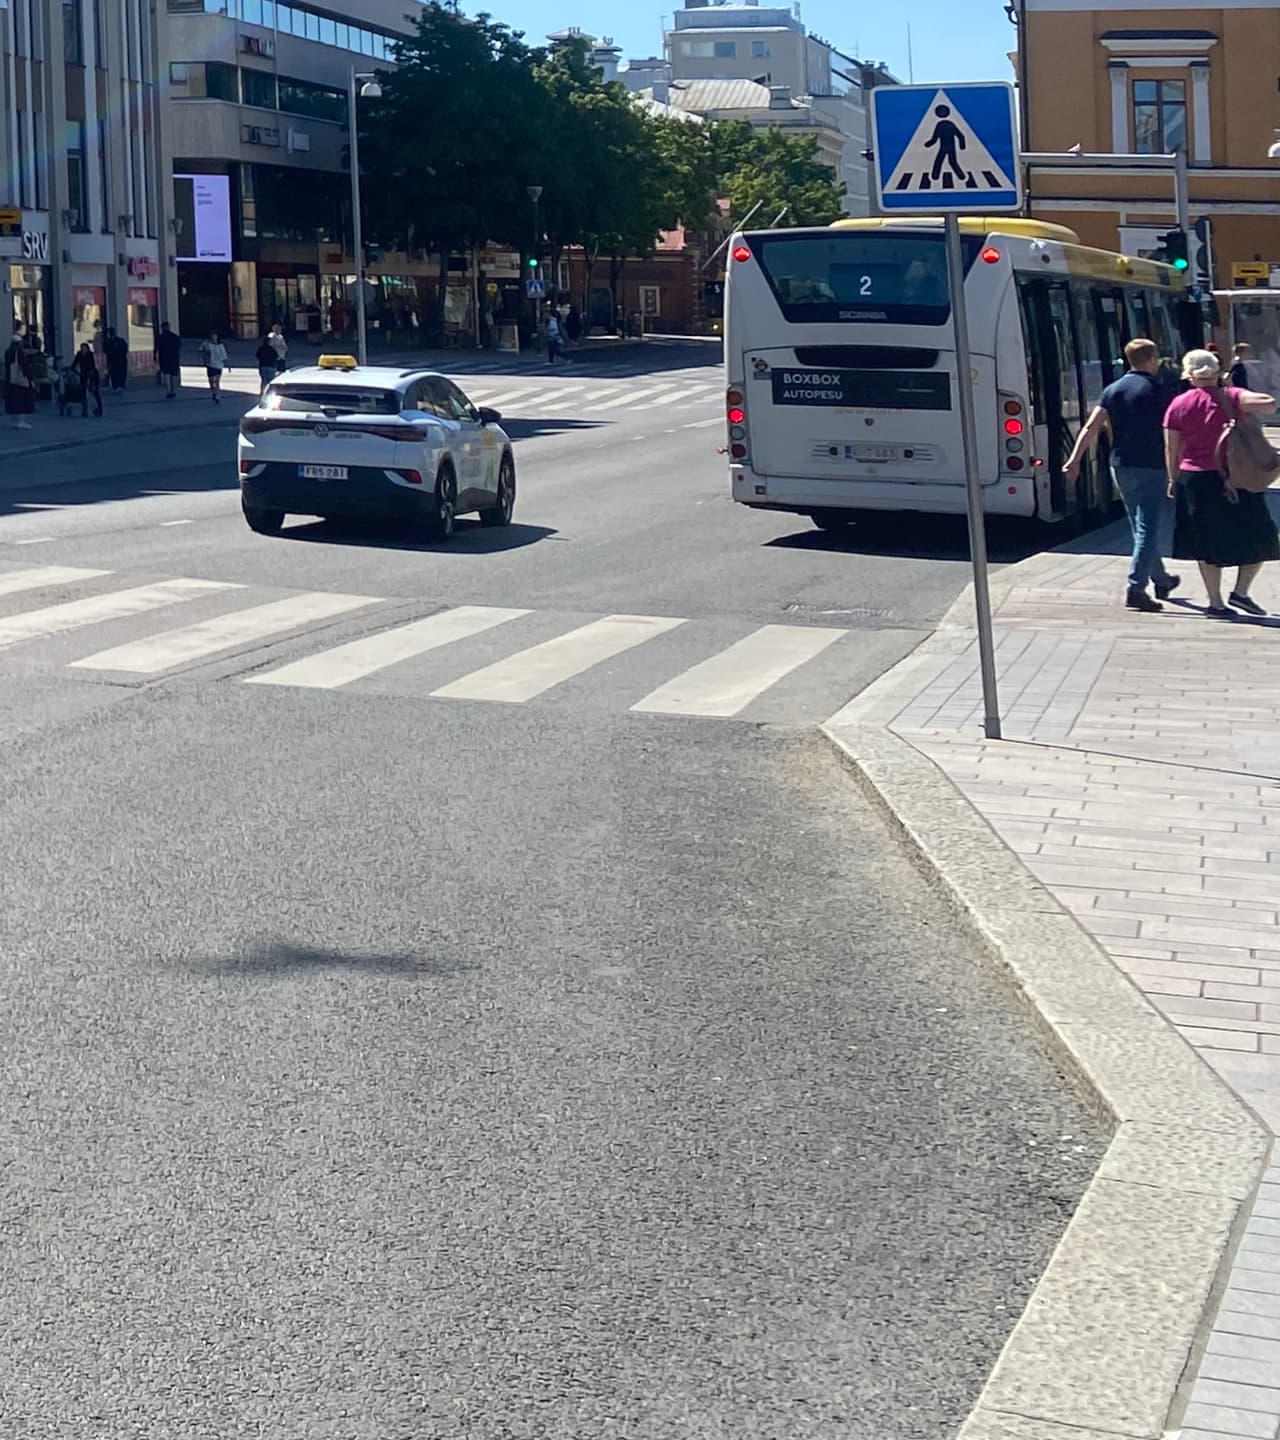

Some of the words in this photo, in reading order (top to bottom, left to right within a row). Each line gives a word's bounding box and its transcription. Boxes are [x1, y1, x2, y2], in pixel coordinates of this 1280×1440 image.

[23, 231, 49, 259] SRV
[860, 275, 872, 295] 2
[783, 373, 841, 385] BOXBOX
[783, 389, 844, 400] AUTOPESU
